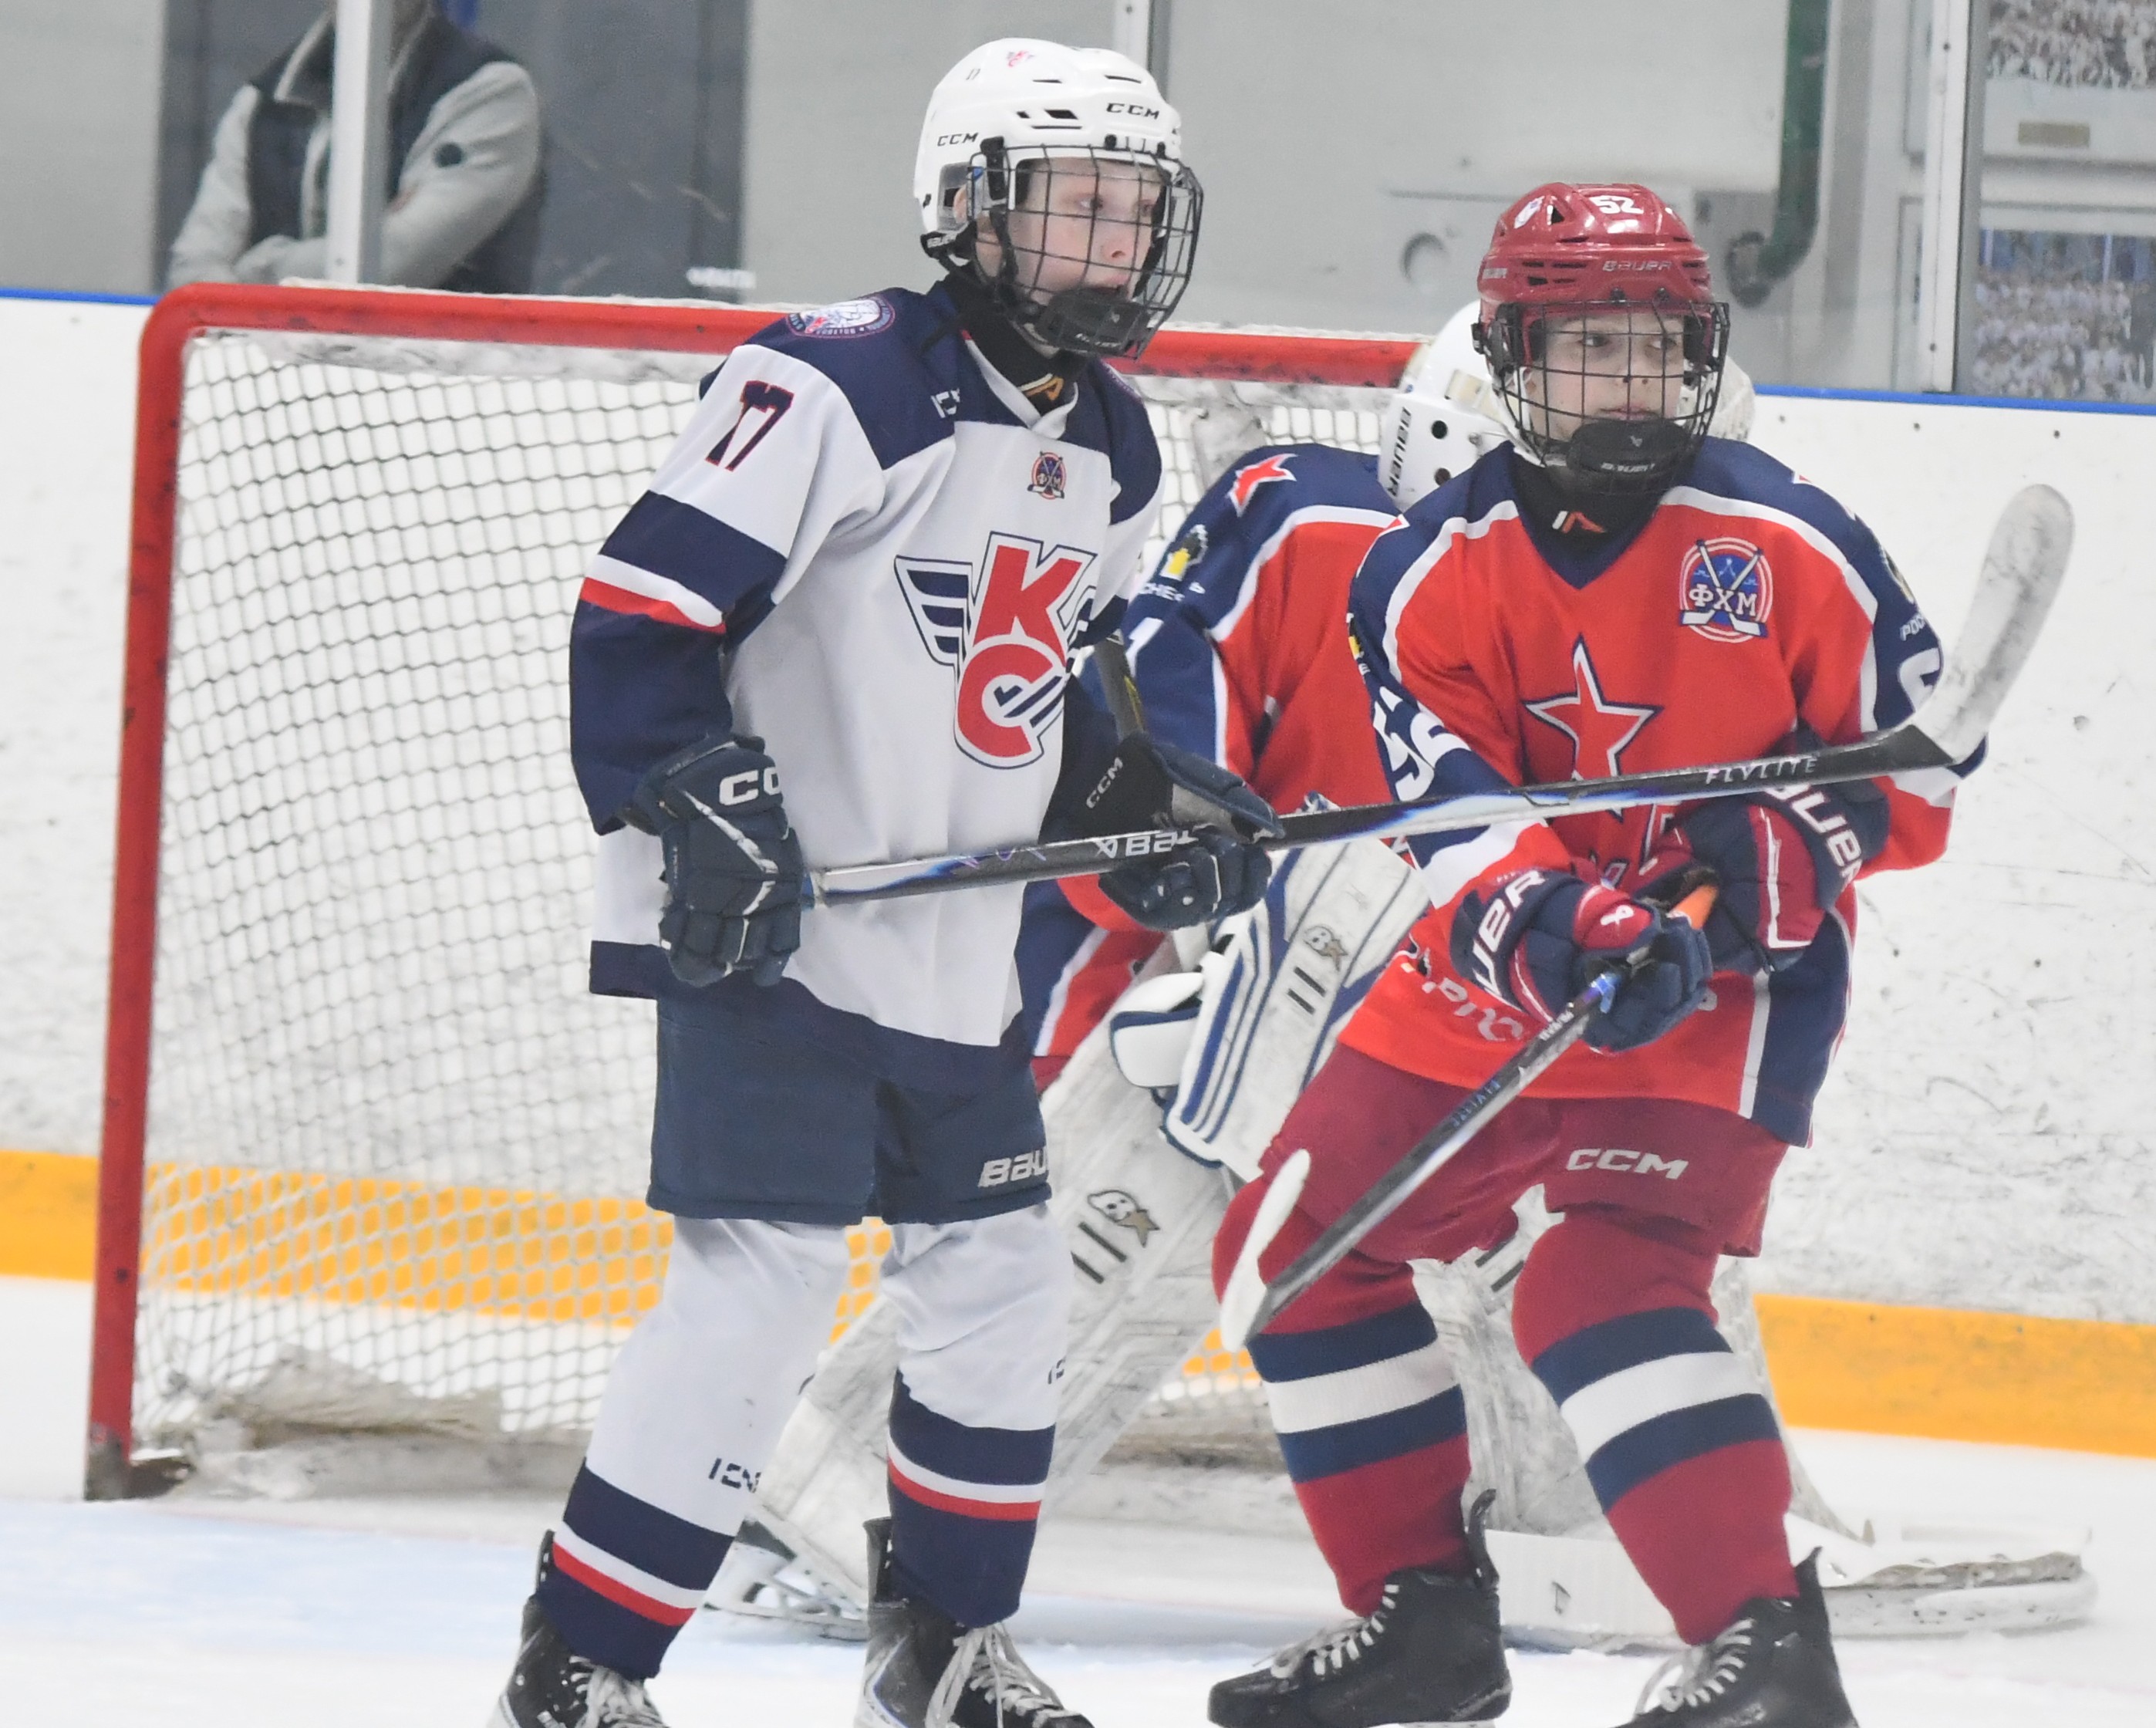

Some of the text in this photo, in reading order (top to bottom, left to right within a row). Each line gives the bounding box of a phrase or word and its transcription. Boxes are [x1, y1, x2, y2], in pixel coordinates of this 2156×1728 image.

[1105, 101, 1160, 120] CCM
[936, 132, 979, 147] CCM
[1588, 194, 1645, 214] 52
[704, 380, 795, 472] 17
[1689, 583, 1758, 617] ФХМ
[1085, 757, 1124, 809] CCM
[1565, 1148, 1689, 1180] CCM
